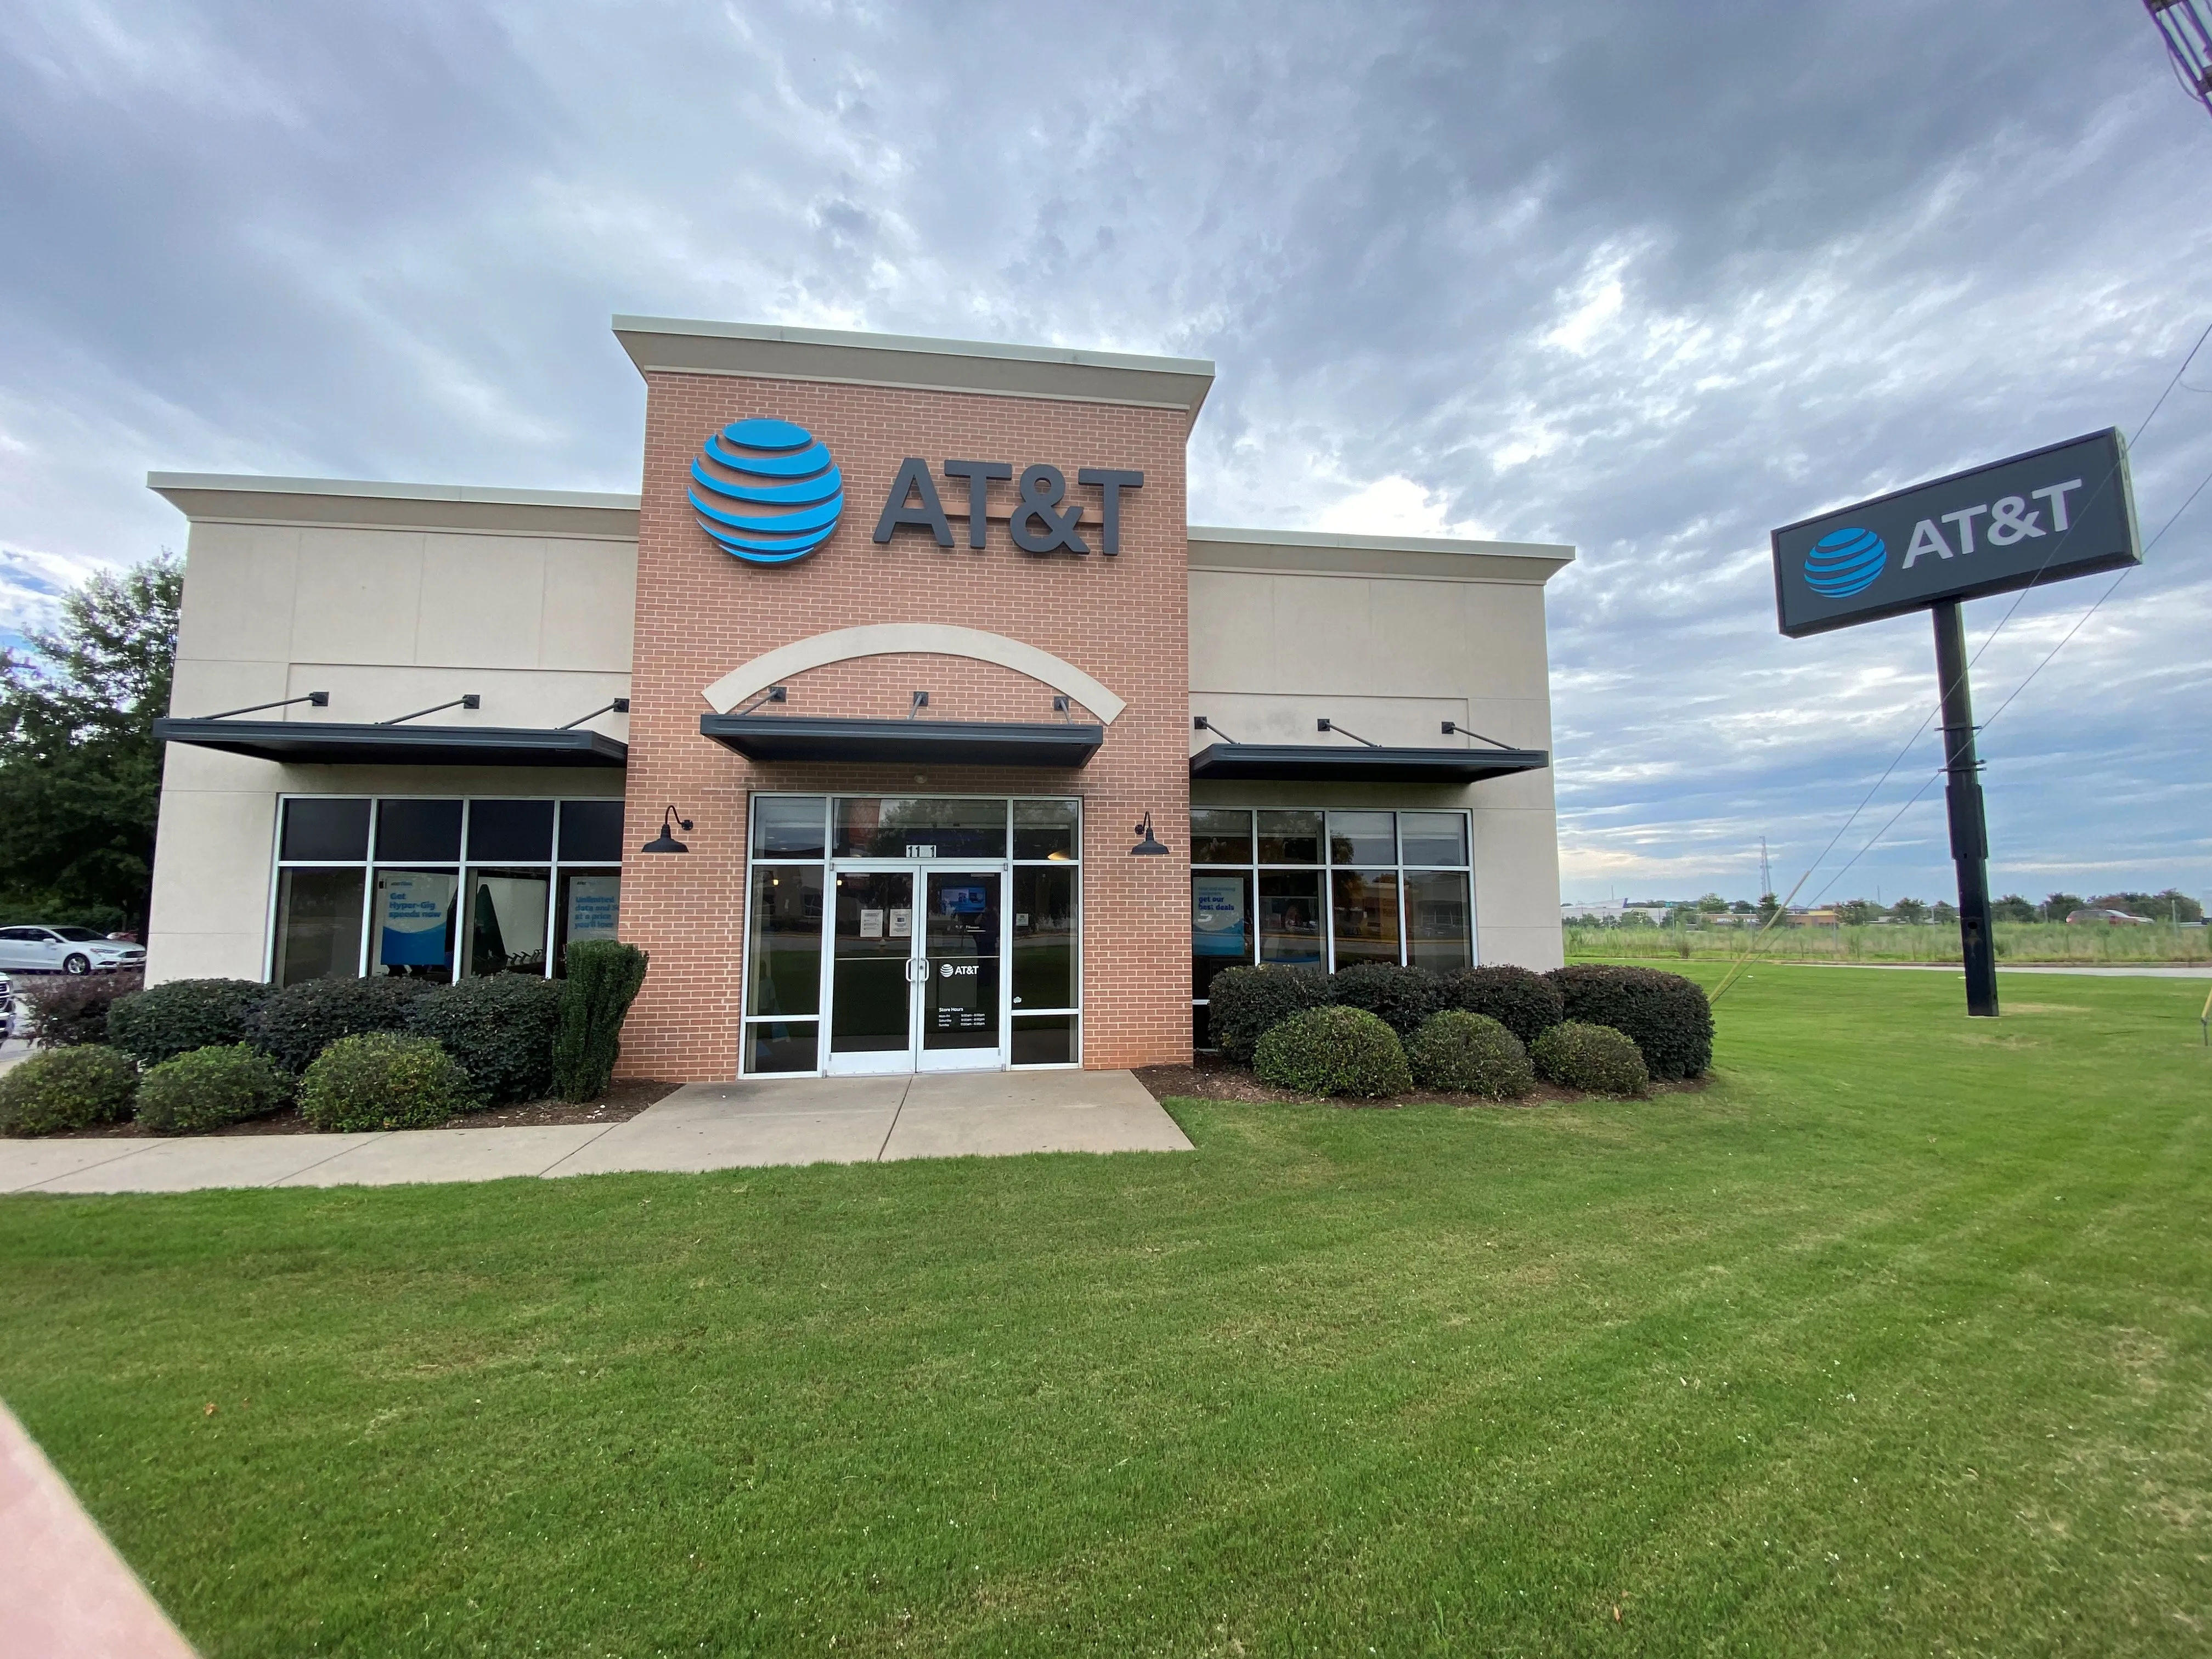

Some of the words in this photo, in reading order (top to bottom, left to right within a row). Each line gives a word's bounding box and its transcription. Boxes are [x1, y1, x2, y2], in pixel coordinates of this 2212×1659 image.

[872, 458, 1144, 556] AT&T
[1901, 478, 2083, 570] AT&T
[955, 966, 979, 975] AT&T
